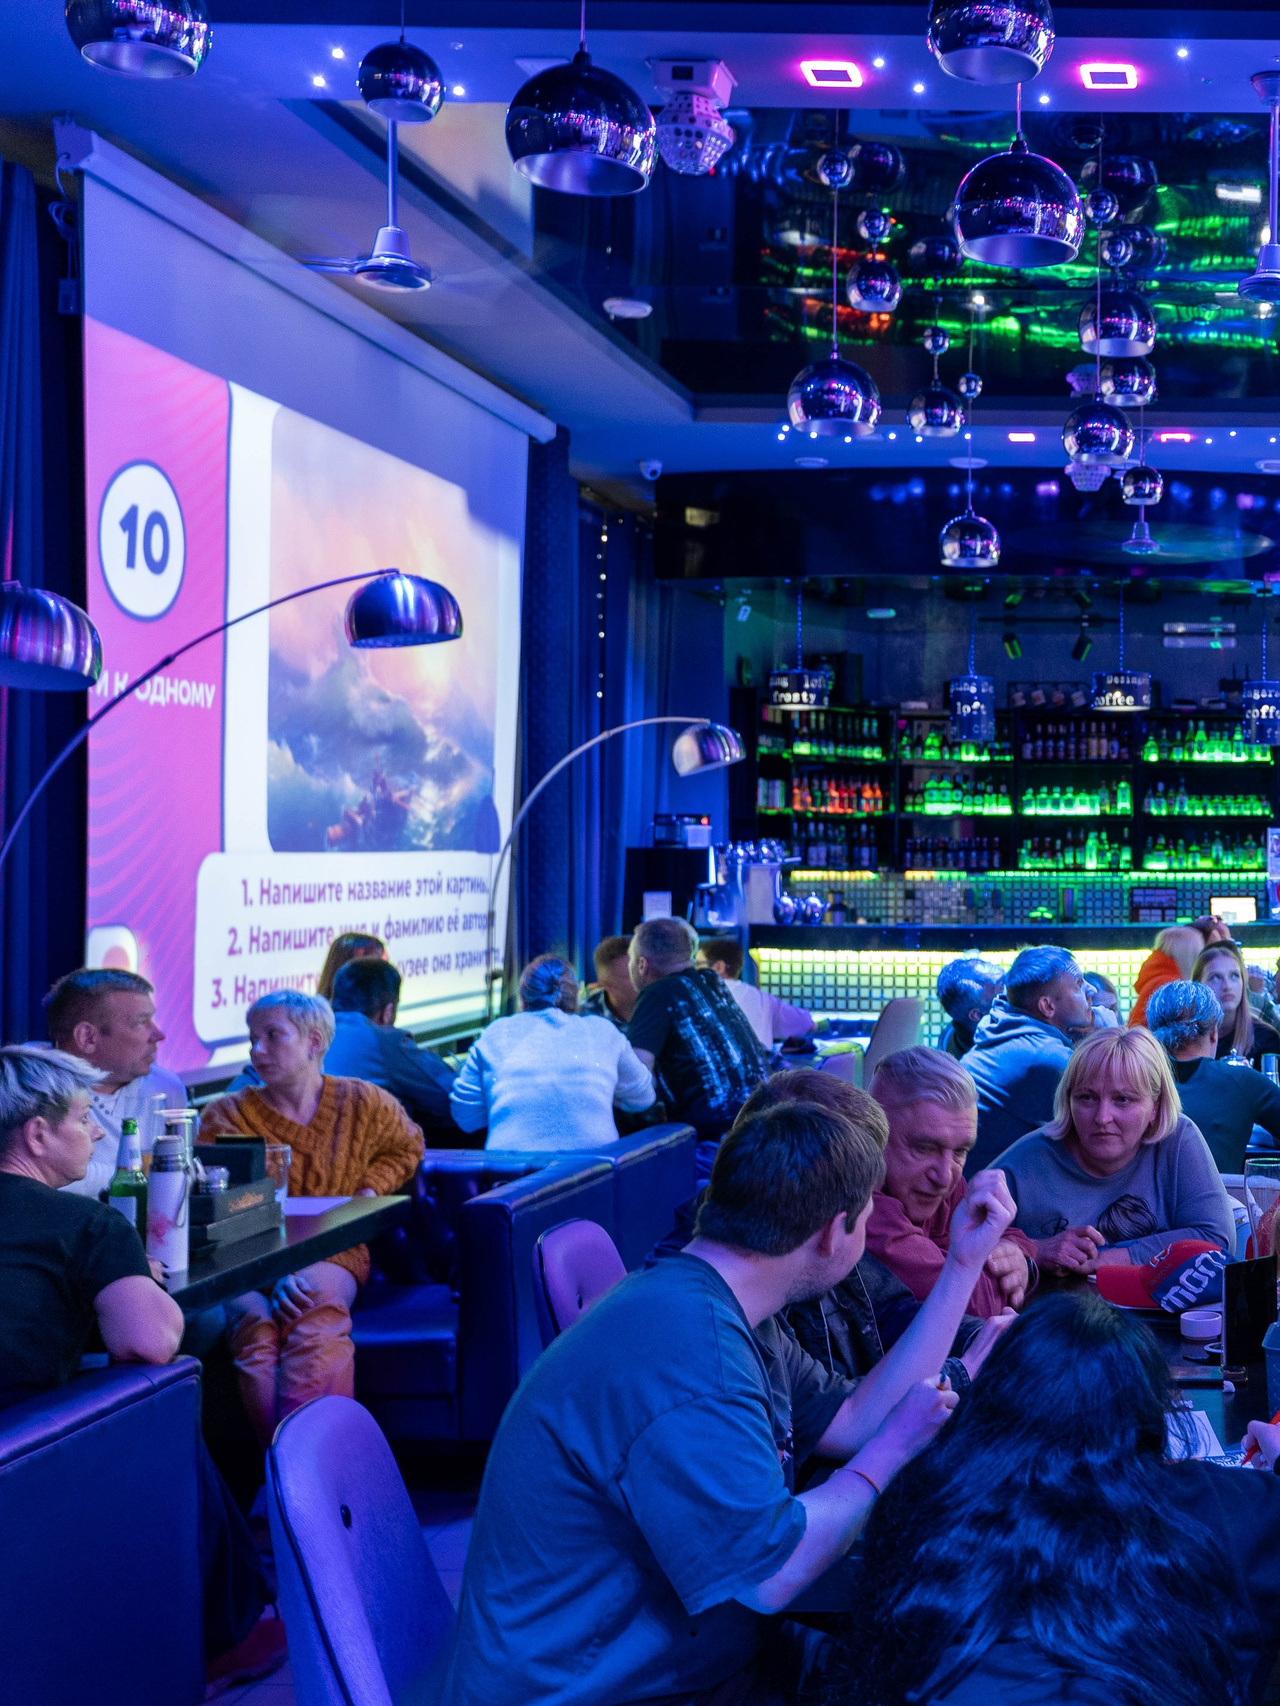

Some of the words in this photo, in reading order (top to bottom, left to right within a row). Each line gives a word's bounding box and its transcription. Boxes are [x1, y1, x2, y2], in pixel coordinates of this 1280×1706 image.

[119, 503, 170, 576] 10
[241, 879, 253, 906] 1.
[260, 879, 343, 905] Напишите
[347, 879, 412, 901] название
[415, 871, 443, 896] этой
[227, 926, 242, 956] 2.
[249, 924, 335, 954] Напишите
[384, 914, 444, 941] фамилию
[447, 909, 459, 932] её
[211, 978, 227, 1008] 3.
[432, 956, 451, 974] она
